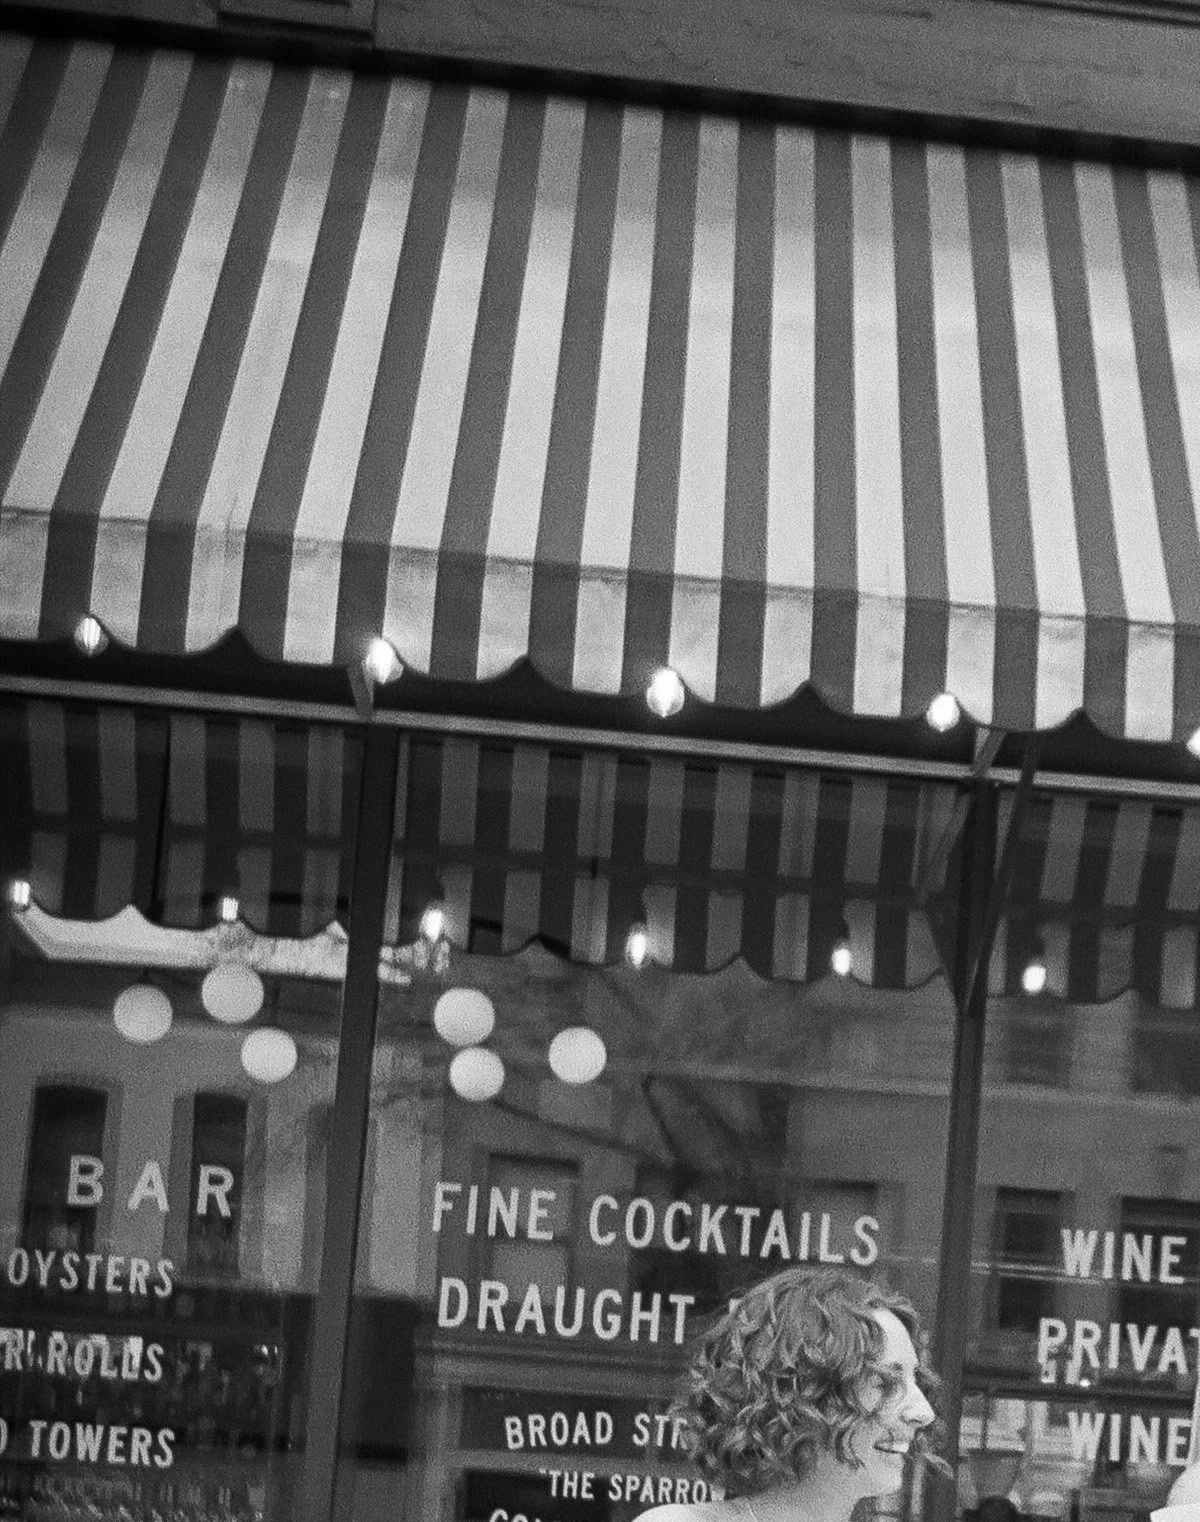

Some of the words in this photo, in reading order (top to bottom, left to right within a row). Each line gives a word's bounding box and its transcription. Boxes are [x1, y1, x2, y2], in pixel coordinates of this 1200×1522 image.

[66, 1154, 234, 1217] BAR
[432, 1181, 556, 1241] FINE
[588, 1195, 881, 1266] COCKTAILS
[8, 1249, 174, 1298] OYSTERS
[1060, 1228, 1187, 1285] WINE
[437, 1276, 696, 1345] DRAUGHT
[29, 1420, 175, 1468] TOWERS
[505, 1412, 613, 1450] BROAD
[1068, 1412, 1192, 1466] WINE
